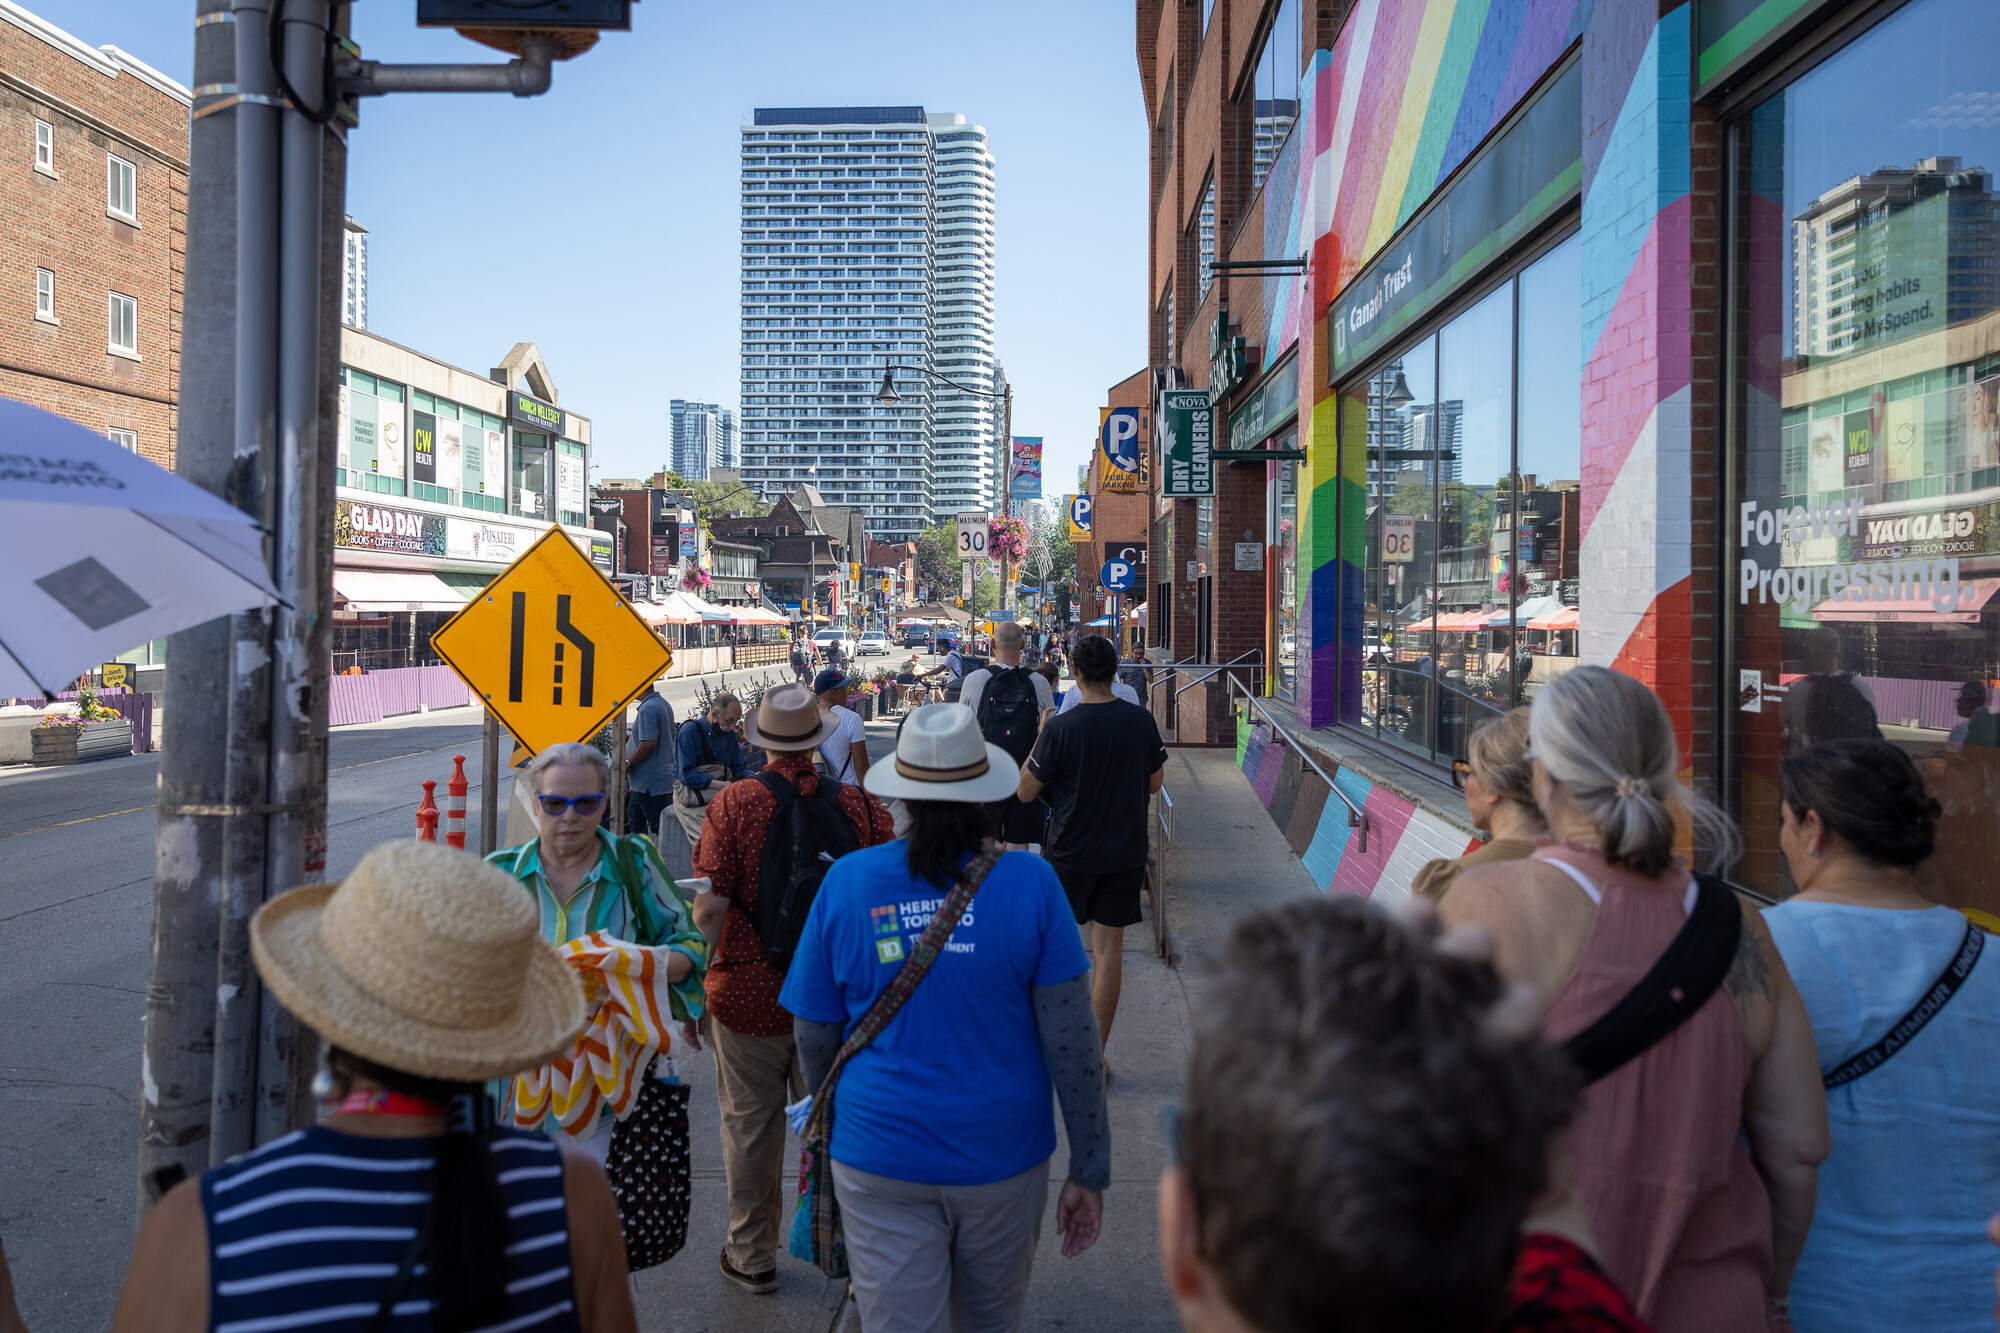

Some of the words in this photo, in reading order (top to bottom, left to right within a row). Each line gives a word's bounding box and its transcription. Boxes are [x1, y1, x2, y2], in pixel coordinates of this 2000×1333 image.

[1876, 277, 1920, 306] habits
[1335, 318, 1345, 357] TD
[1383, 252, 1412, 303] Trust
[519, 397, 537, 416] CHURCH
[537, 404, 560, 424] WELLESLEY
[1178, 397, 1206, 408] NOVA
[415, 428, 432, 453] CW
[1110, 414, 1138, 454] P
[415, 451, 432, 466] HEALTH
[1191, 410, 1210, 492] CLEANERS
[1103, 481, 1135, 489] PARKING
[1172, 459, 1189, 492] DRY
[960, 517, 986, 525] MAXIMUM
[1075, 499, 1091, 521] P
[351, 505, 394, 534] GLAD
[395, 512, 424, 538] DAY
[1740, 497, 1865, 548] Forever
[350, 534, 370, 546] BOOKS
[375, 537, 395, 548] COFFEE
[399, 539, 424, 551] COCKTAILS
[960, 531, 985, 552] 30
[1110, 563, 1128, 583] P
[1740, 556, 1974, 615] Progressing.
[107, 674, 124, 683] prices
[108, 668, 121, 676] best
[900, 898, 974, 916] HERITE
[879, 941, 901, 958] TD
[1826, 1051, 1883, 1087] NDER
[1884, 983, 1950, 1053] ARMOUR
